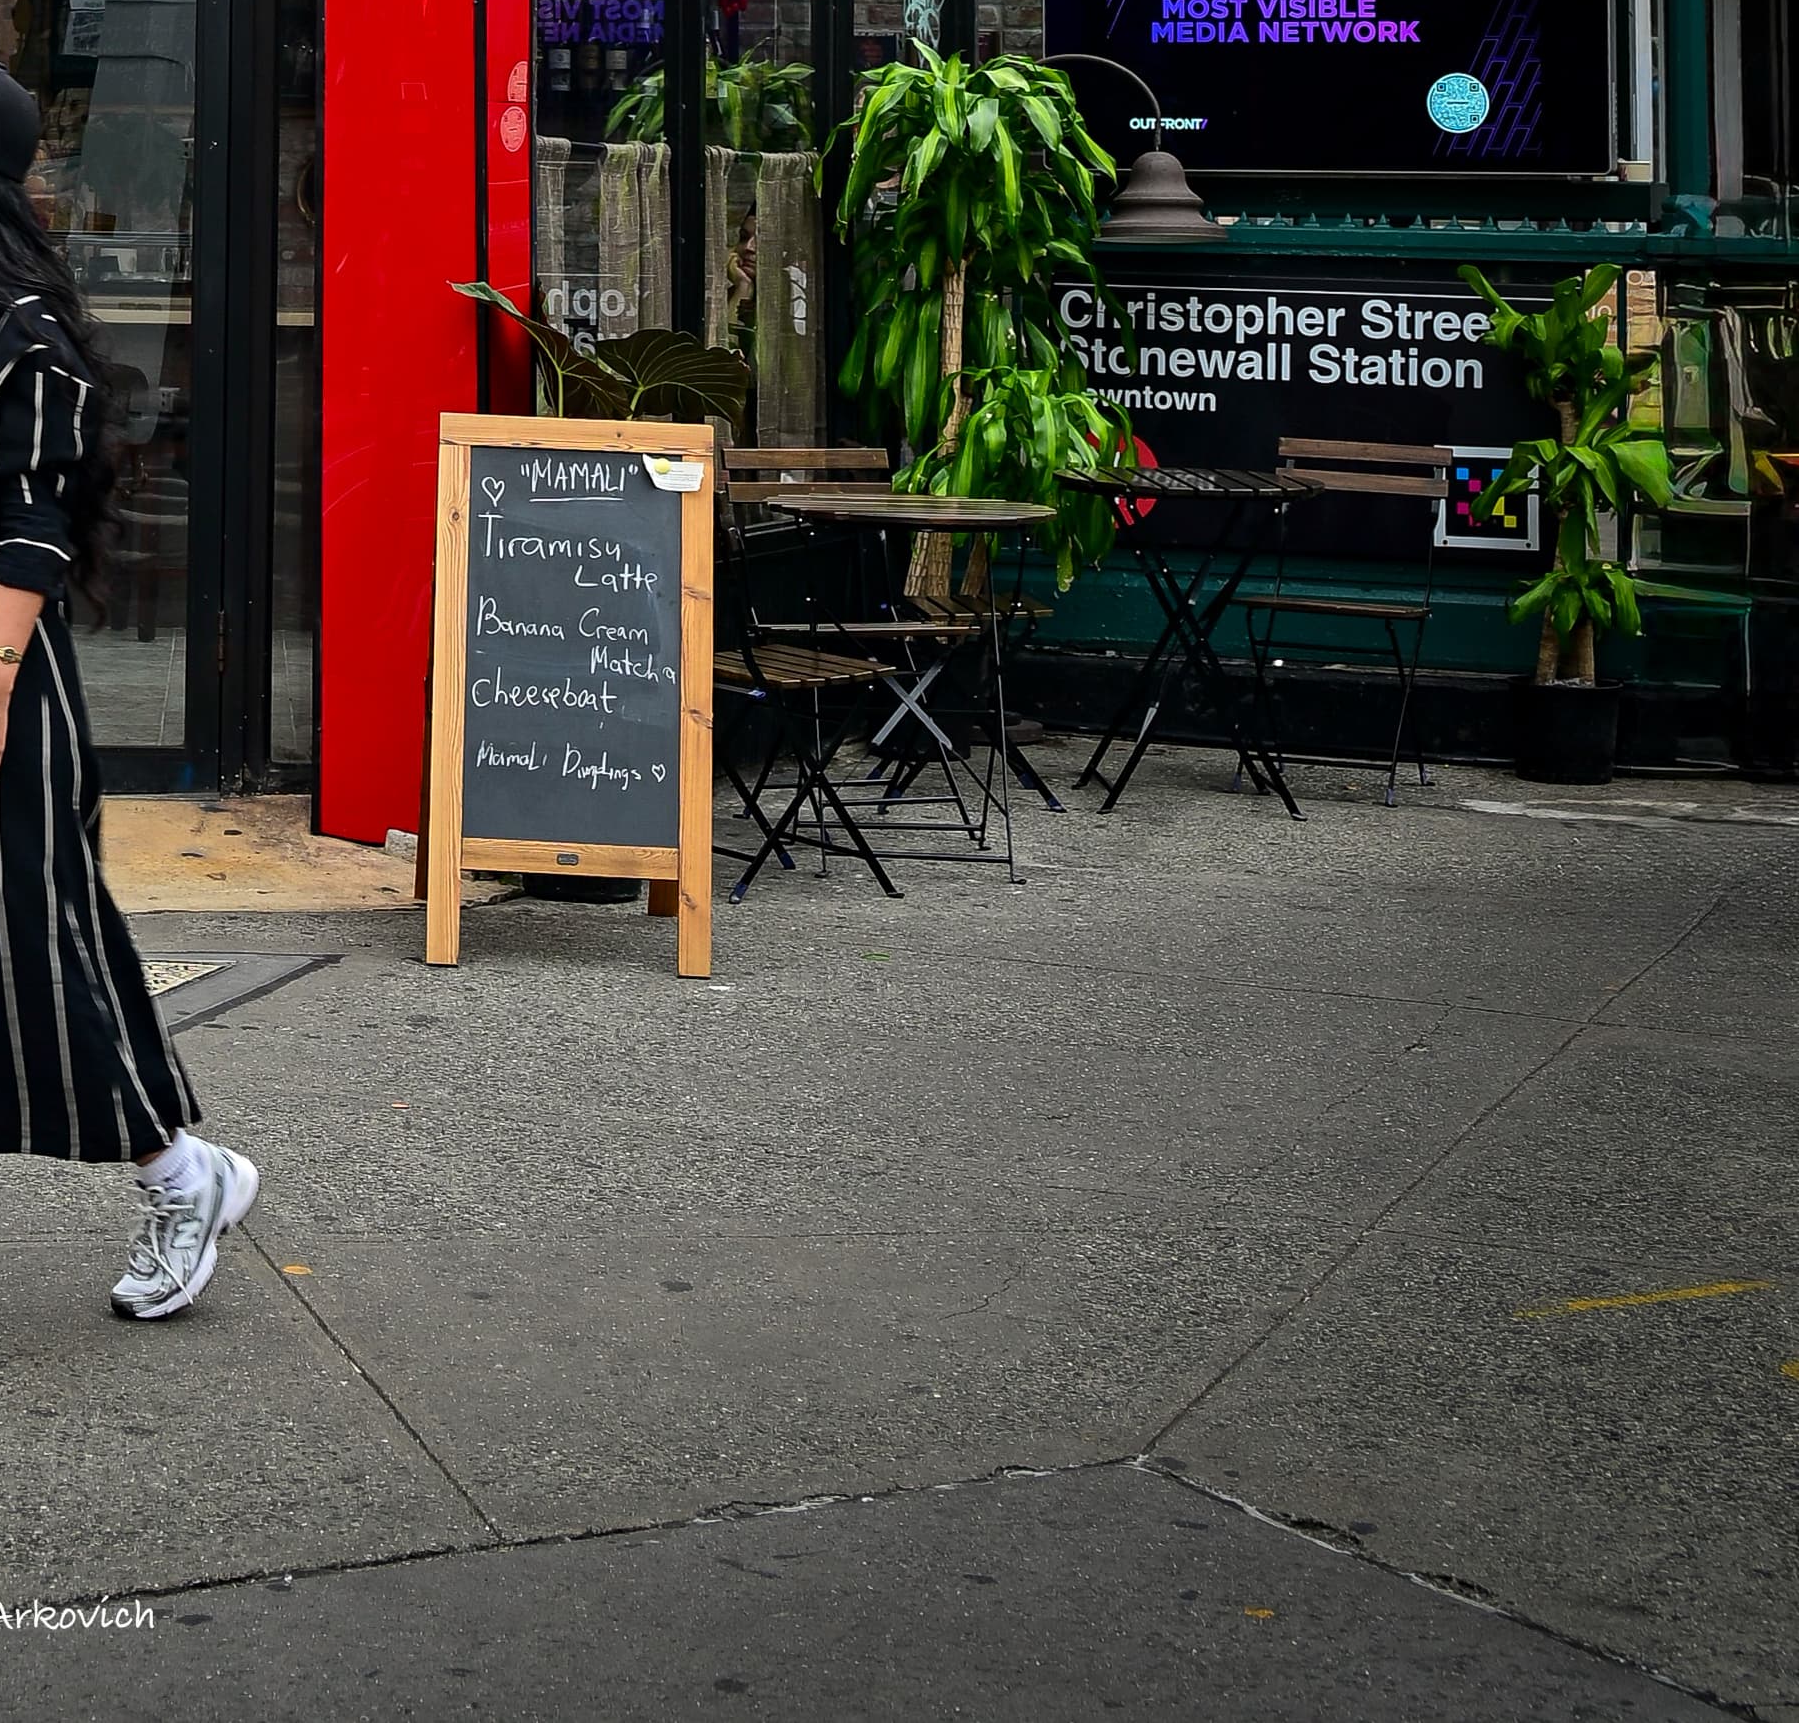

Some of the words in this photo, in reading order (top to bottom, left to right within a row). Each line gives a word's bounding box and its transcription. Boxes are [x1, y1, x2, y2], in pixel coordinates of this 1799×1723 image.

[1151, 20, 1250, 44] MEDIA
[1258, 20, 1421, 44] NETWORK
[1360, 298, 1491, 343] Stree
[1307, 342, 1484, 389] Station
[1085, 385, 1217, 412] owntown
[574, 563, 658, 594] Latte
[476, 595, 565, 640] Banana
[578, 607, 649, 646] Cream
